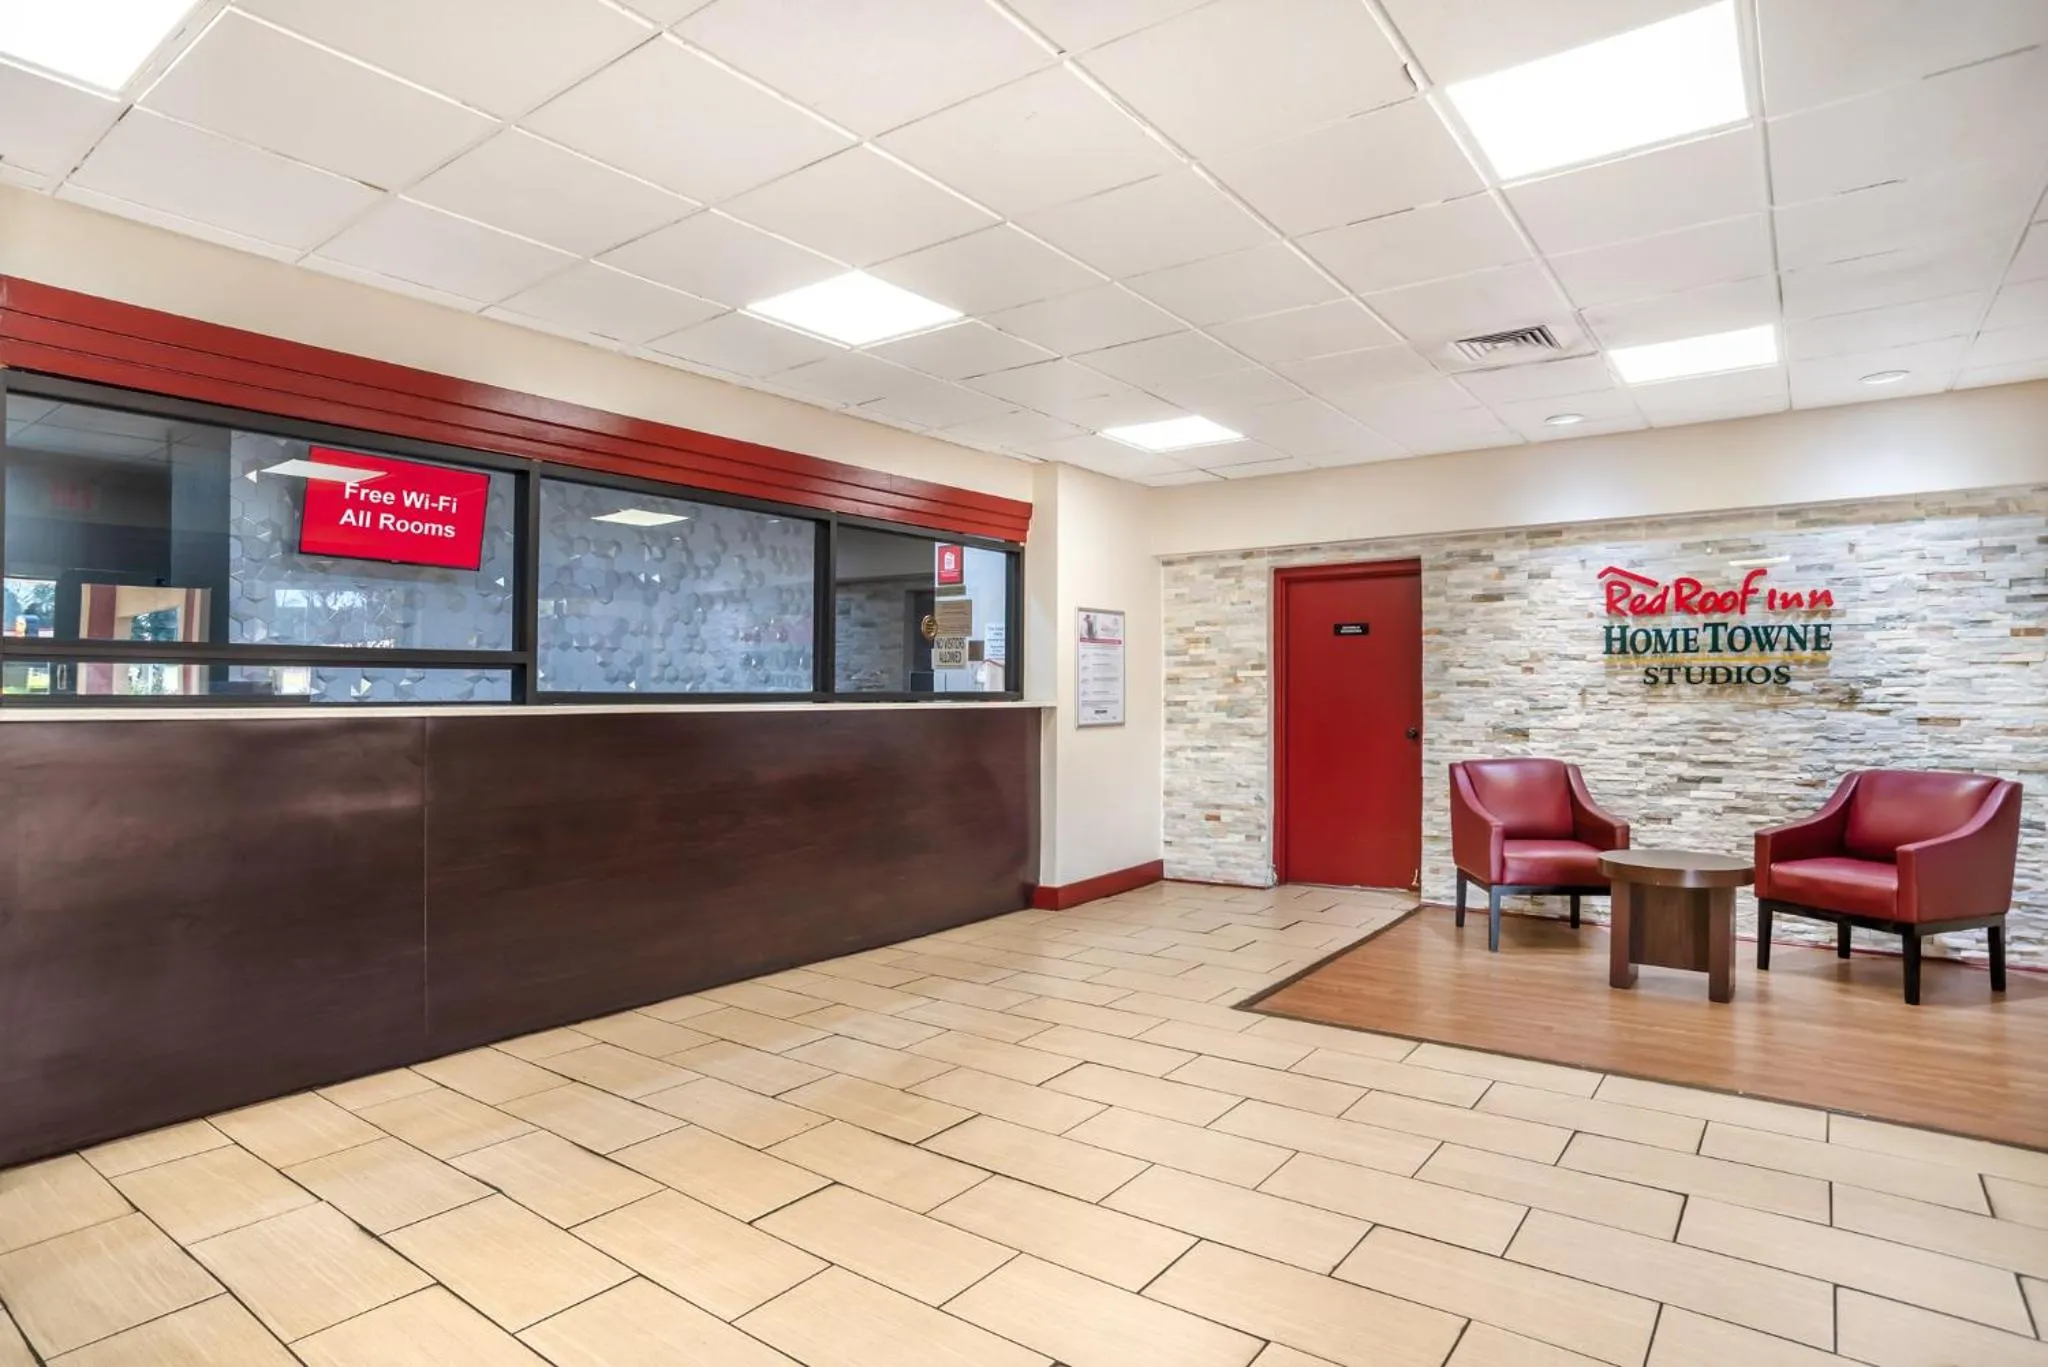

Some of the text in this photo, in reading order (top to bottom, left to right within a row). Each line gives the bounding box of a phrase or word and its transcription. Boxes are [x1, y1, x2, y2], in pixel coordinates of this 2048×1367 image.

[344, 481, 457, 514] Free Wi-Fi
[339, 508, 456, 538] All Rooms
[1604, 579, 1670, 617] Red
[1673, 567, 1768, 616] Roof
[1643, 665, 1792, 686] STUDIOS
